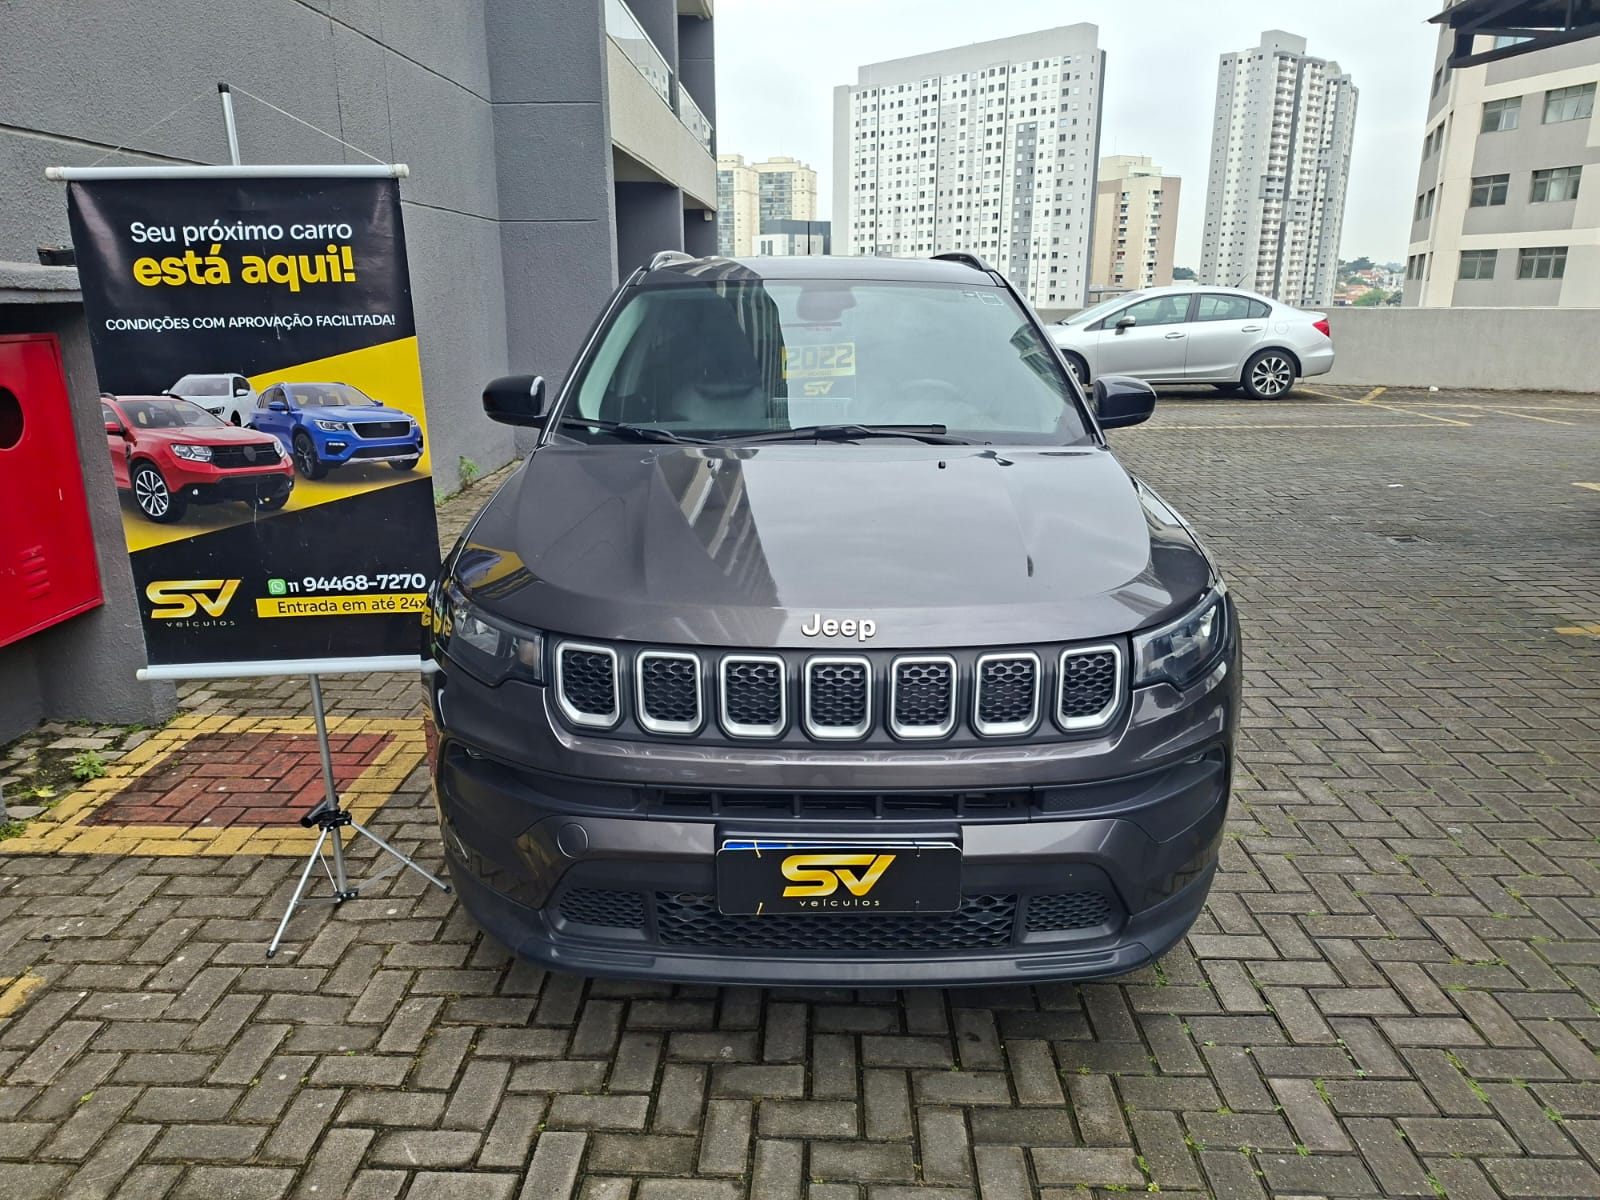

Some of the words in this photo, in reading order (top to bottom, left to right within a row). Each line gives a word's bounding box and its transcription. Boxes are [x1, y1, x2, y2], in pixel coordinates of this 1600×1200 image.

[130, 221, 177, 243] Seu
[183, 219, 284, 246] próximo
[289, 222, 353, 240] carro
[133, 244, 231, 287] está
[241, 244, 357, 292] aqui!
[105, 315, 190, 332] CONDIÇÕES
[192, 316, 226, 330] COM
[229, 313, 313, 331] APROVAÇÃO
[317, 314, 396, 328] FACILITADA!
[287, 581, 300, 593] 11
[302, 573, 427, 592] 94468-7270
[145, 579, 241, 619] SV
[277, 600, 338, 614] Entrada
[342, 602, 367, 611] em
[371, 597, 396, 610] até
[801, 613, 877, 642] Jeep
[781, 854, 896, 896] SV
